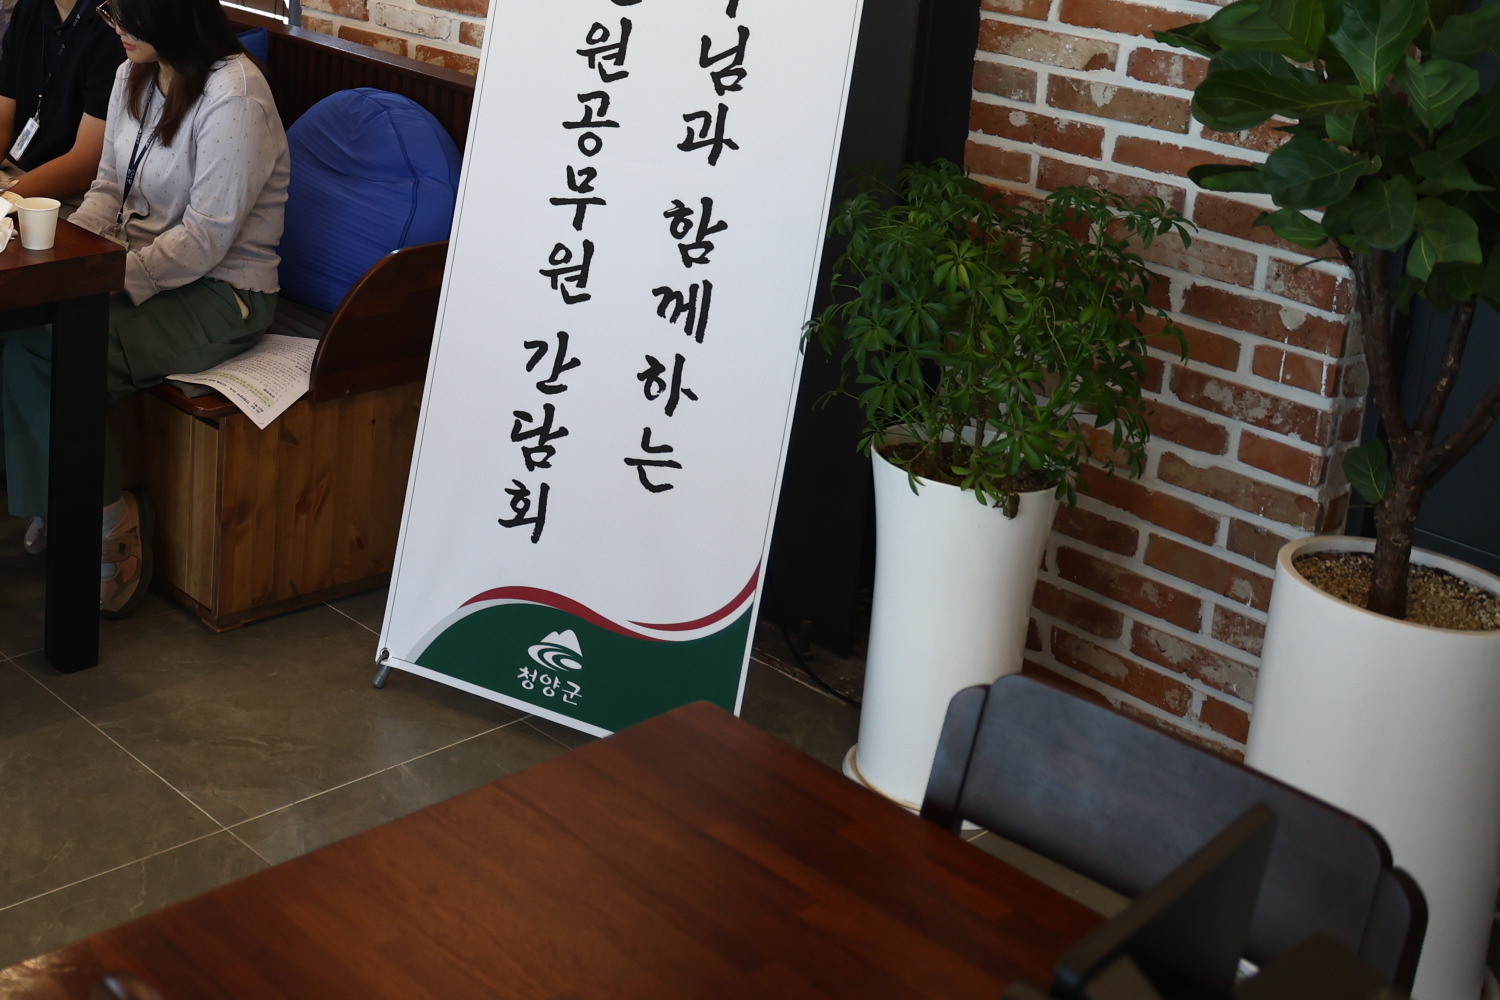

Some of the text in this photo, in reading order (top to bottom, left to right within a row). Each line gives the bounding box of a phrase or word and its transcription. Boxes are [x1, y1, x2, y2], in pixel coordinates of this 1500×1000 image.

[497, 330, 582, 545] 간담회
[623, 196, 729, 494] 함께하는
[517, 666, 583, 706] 청양군
